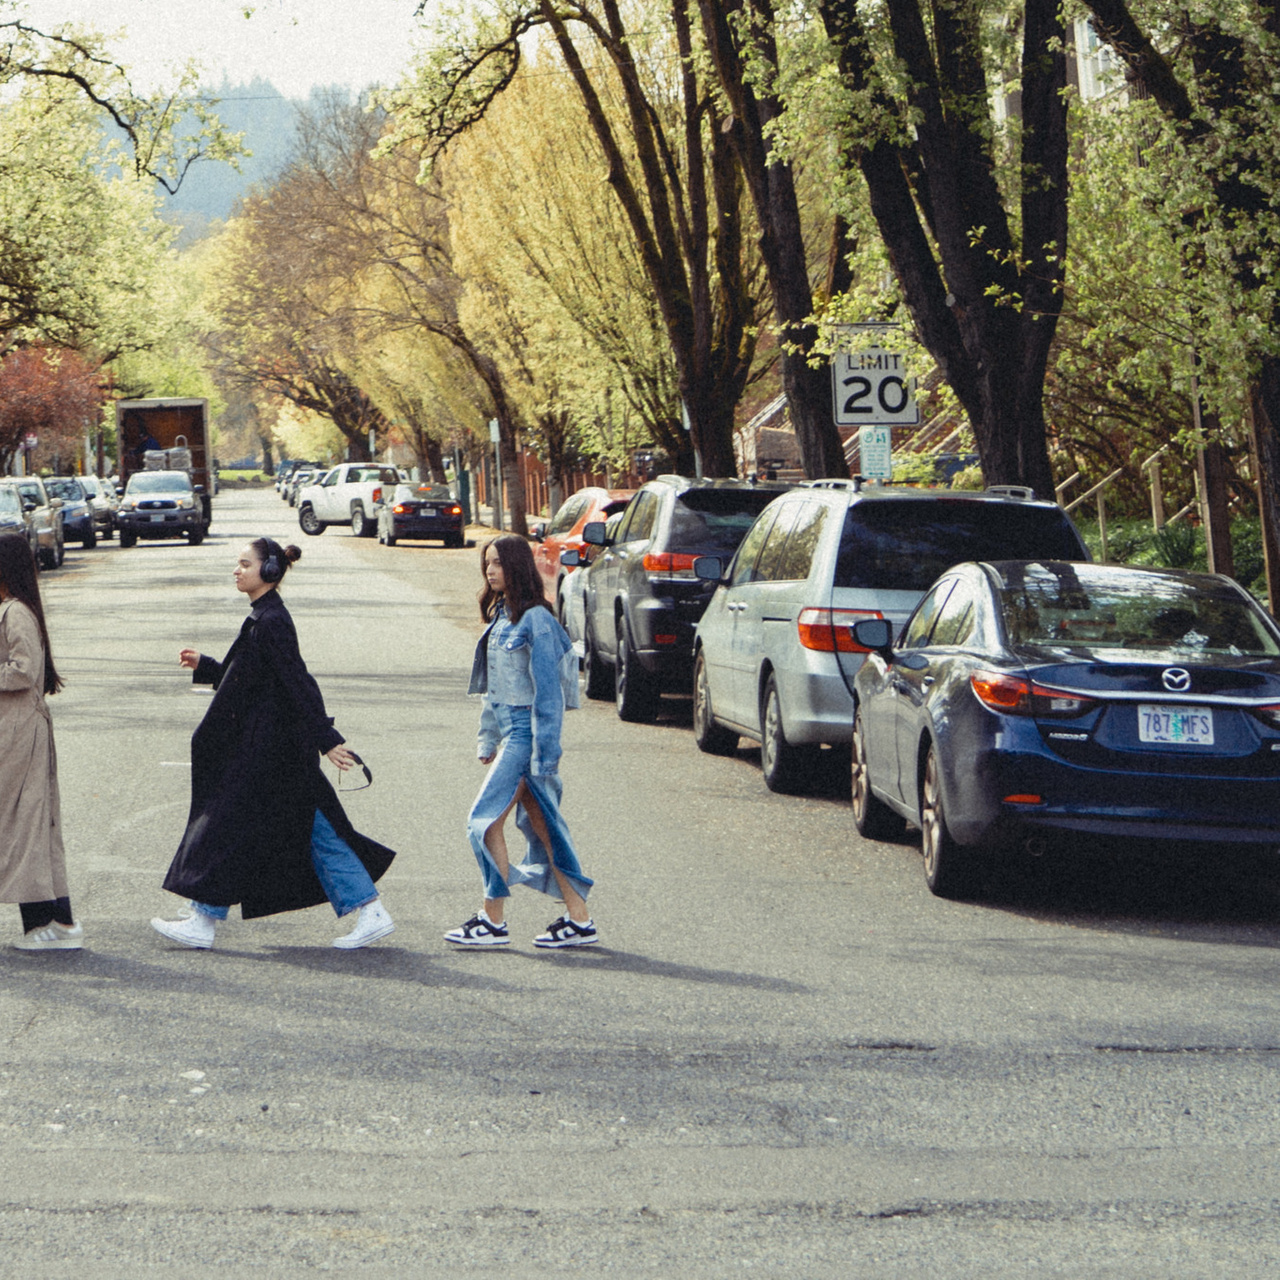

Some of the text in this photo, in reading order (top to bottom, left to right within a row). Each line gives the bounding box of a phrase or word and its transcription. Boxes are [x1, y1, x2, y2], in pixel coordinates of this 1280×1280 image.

[847, 354, 901, 370] LIMIT
[842, 375, 908, 414] 20
[1143, 712, 1210, 735] 787 MFS
